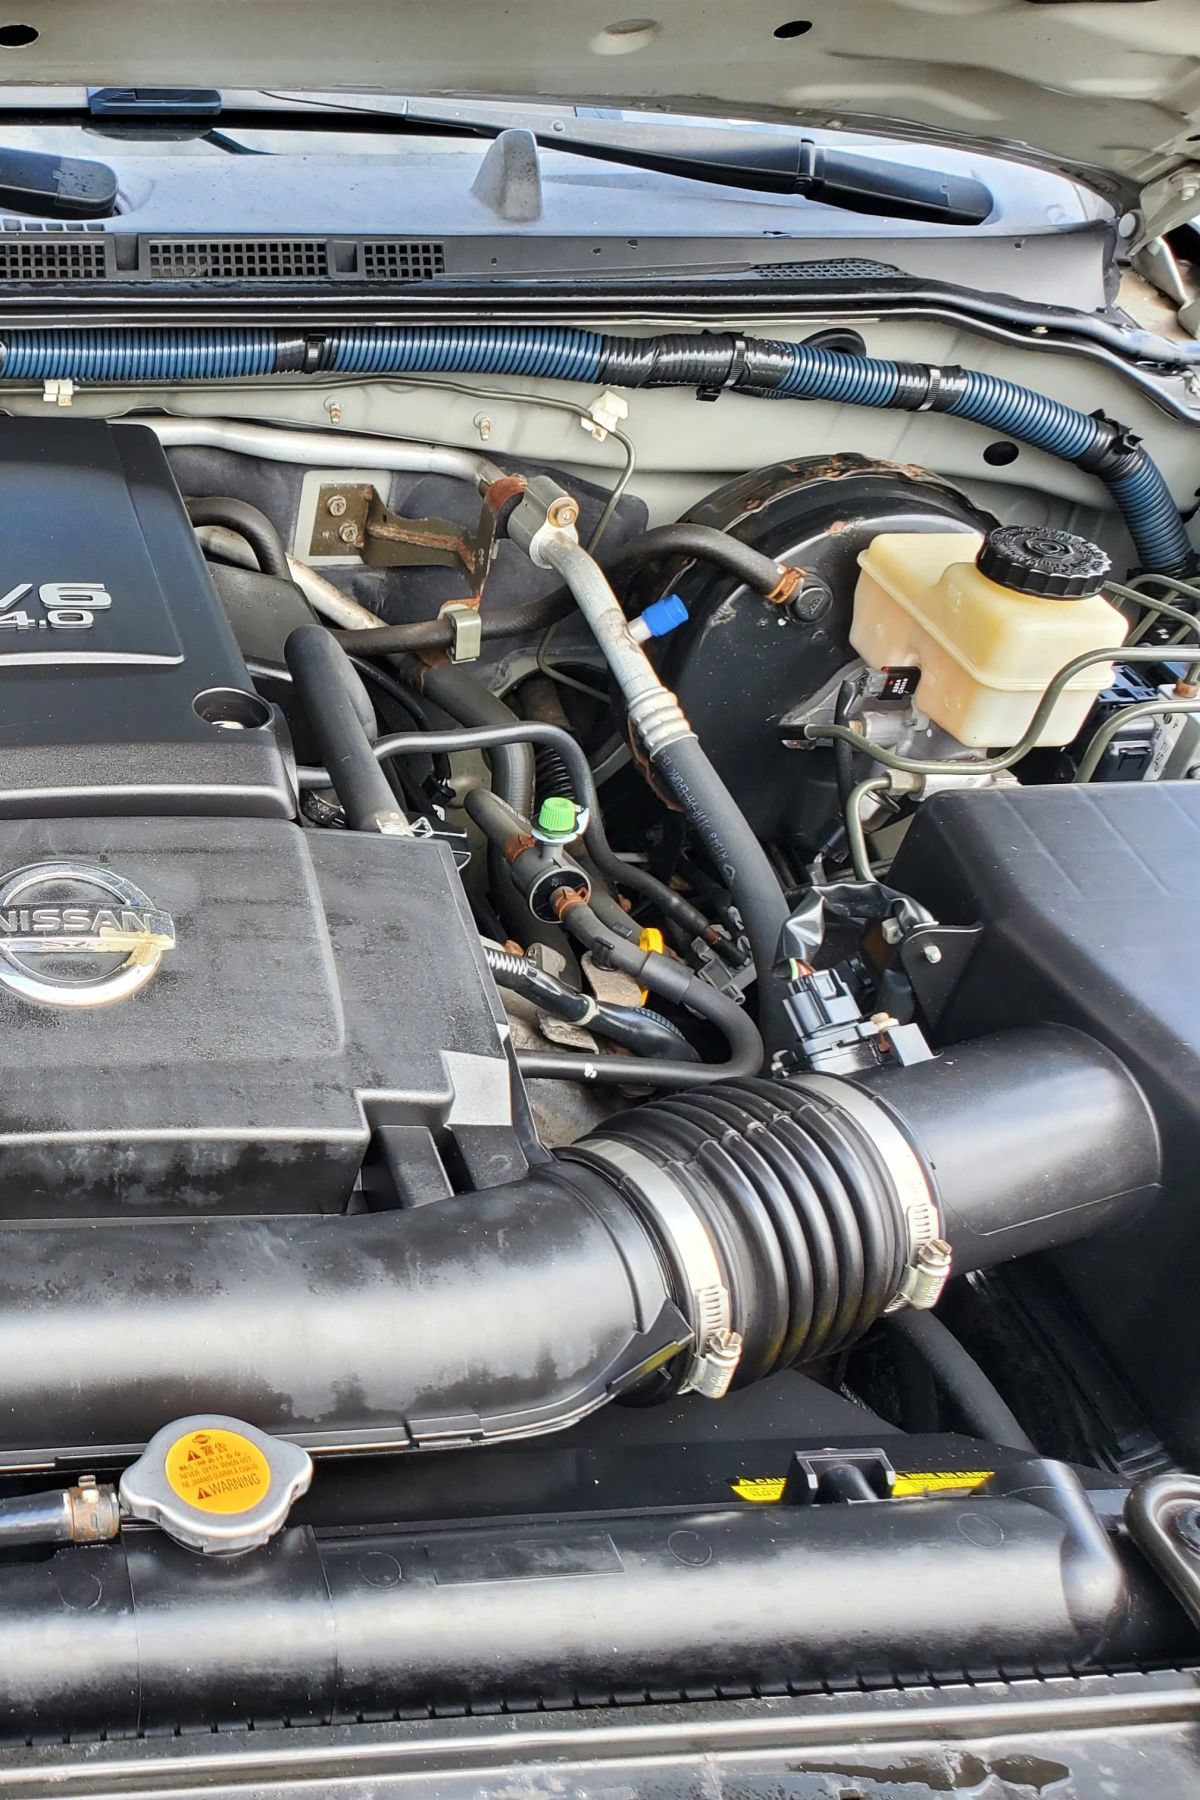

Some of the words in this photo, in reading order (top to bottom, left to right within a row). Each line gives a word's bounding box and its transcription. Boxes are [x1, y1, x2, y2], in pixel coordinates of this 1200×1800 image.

[179, 1468, 200, 1480] NEVER
[202, 1464, 218, 1475] OPEN
[220, 1460, 240, 1469] WHEN
[240, 1455, 252, 1464] HOT
[208, 1473, 261, 1495] WARNING
